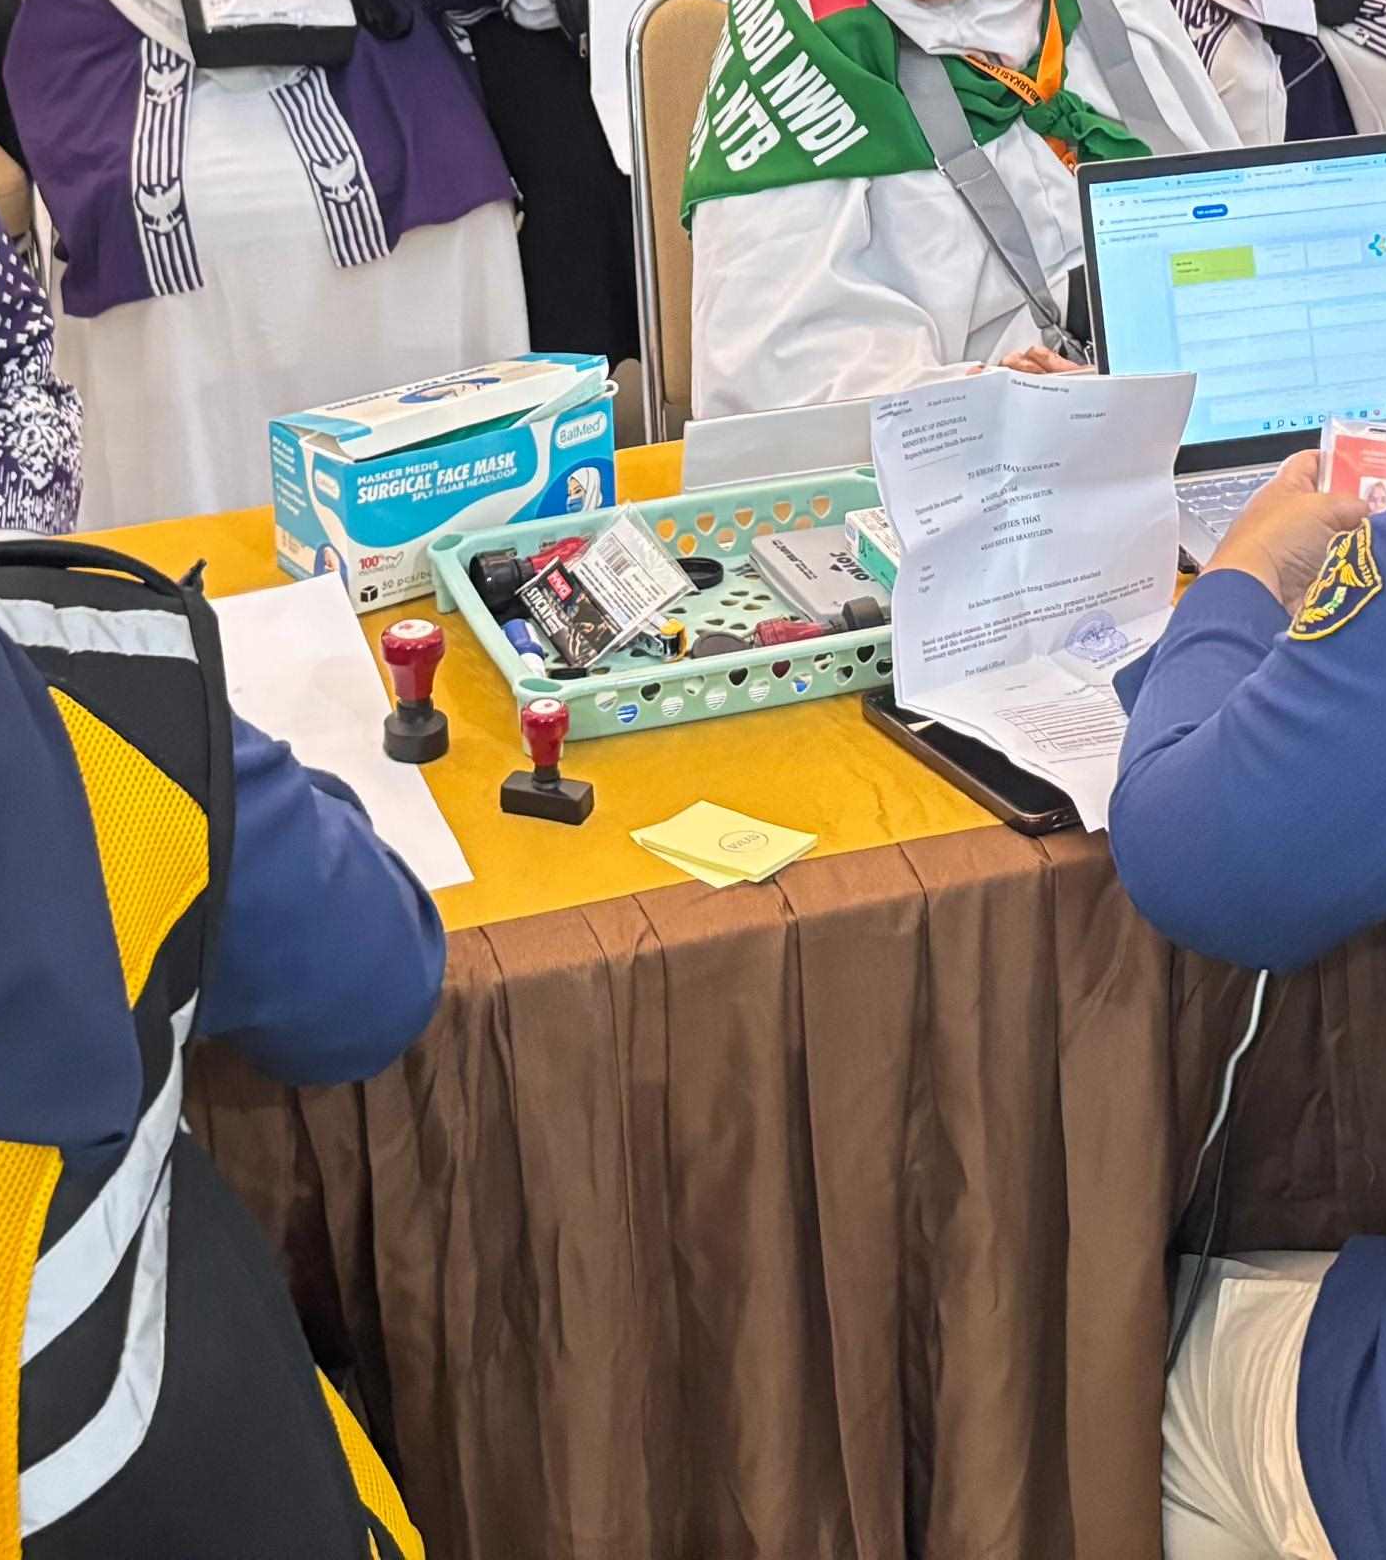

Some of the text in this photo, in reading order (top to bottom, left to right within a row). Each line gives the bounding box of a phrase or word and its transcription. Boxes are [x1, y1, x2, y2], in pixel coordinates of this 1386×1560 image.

[761, 51, 869, 167] NWDI
[357, 460, 440, 486] MASKER MEDIS
[357, 451, 518, 505] SURGICAL FACE MASK
[829, 550, 871, 581] JOYKO
